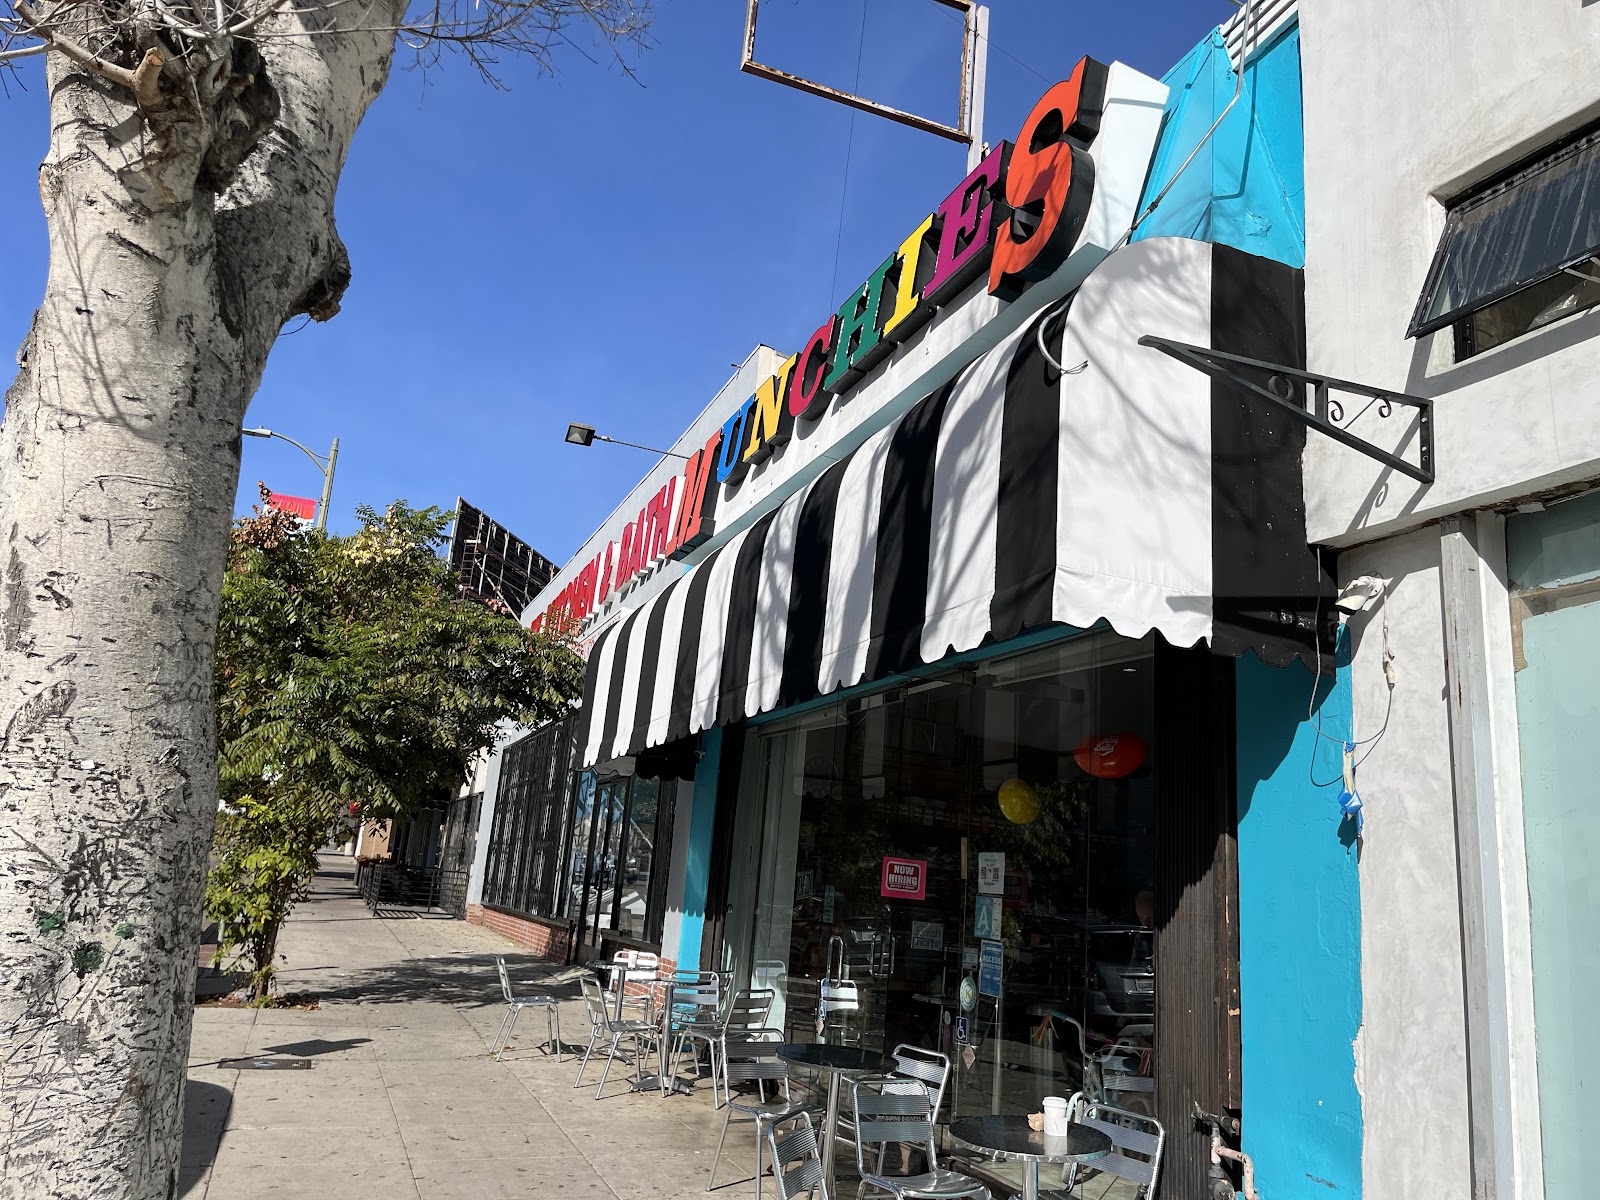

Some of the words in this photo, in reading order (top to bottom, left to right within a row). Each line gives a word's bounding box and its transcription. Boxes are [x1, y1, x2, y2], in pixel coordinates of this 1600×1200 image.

[665, 55, 1103, 564] MUNCHIES
[598, 541, 614, 605] &
[614, 475, 678, 593] BATH
[894, 865, 914, 875] NOW
[889, 874, 917, 886] HIRING
[978, 905, 989, 930] A
[982, 955, 1001, 965] ACCESS
[965, 989, 971, 999] K
